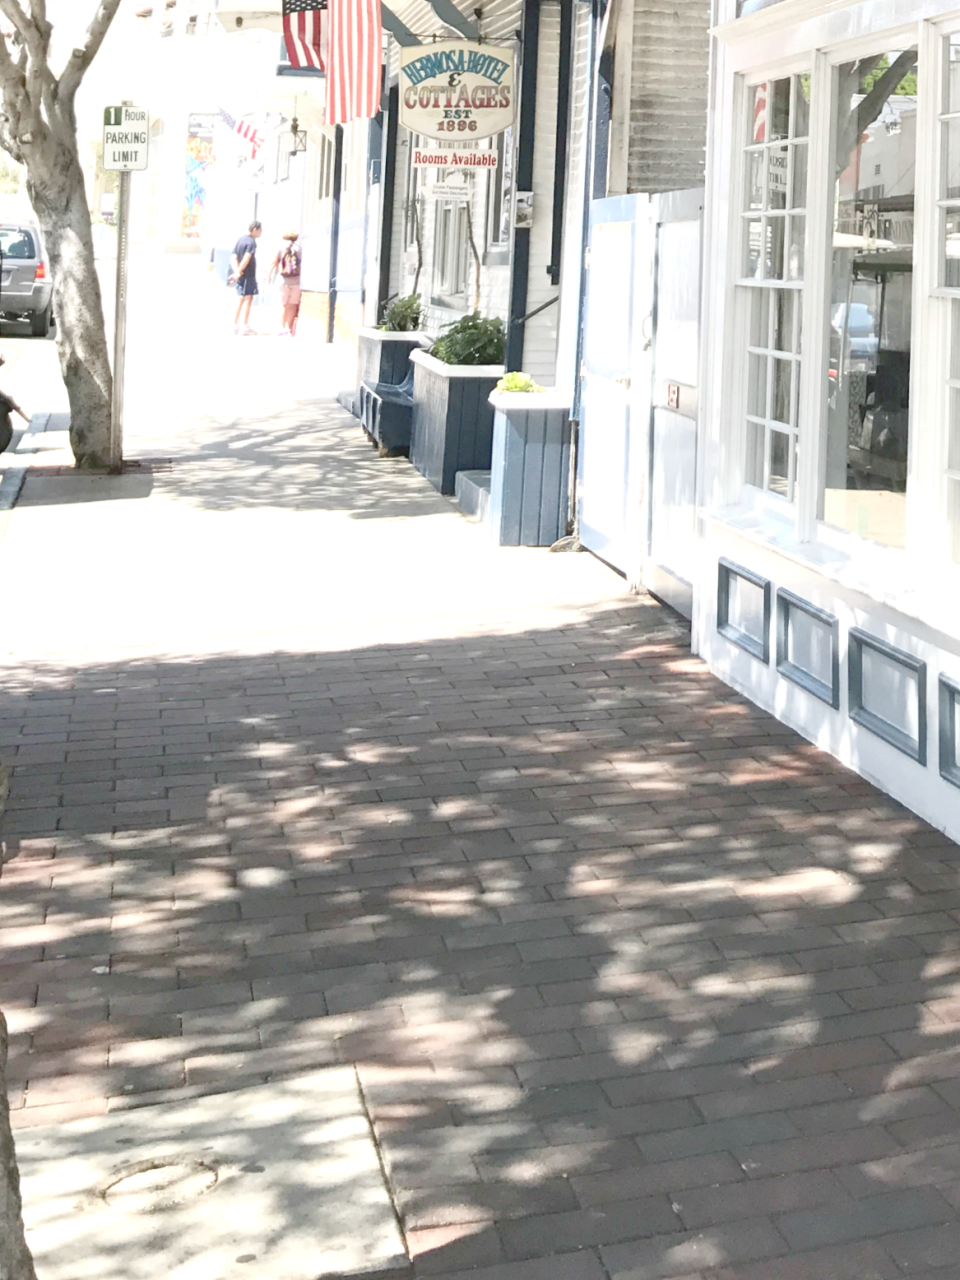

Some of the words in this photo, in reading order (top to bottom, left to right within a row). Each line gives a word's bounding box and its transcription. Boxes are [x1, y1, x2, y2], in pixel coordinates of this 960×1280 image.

[404, 83, 511, 109] COTTAGES
[109, 107, 116, 125] 1
[124, 111, 146, 121] HOUR
[443, 109, 472, 119] EST
[436, 120, 478, 132] 1896
[105, 131, 147, 144] PARKING
[112, 150, 139, 162] LIMIT
[414, 151, 448, 165] Rooms
[450, 152, 497, 166] Available
